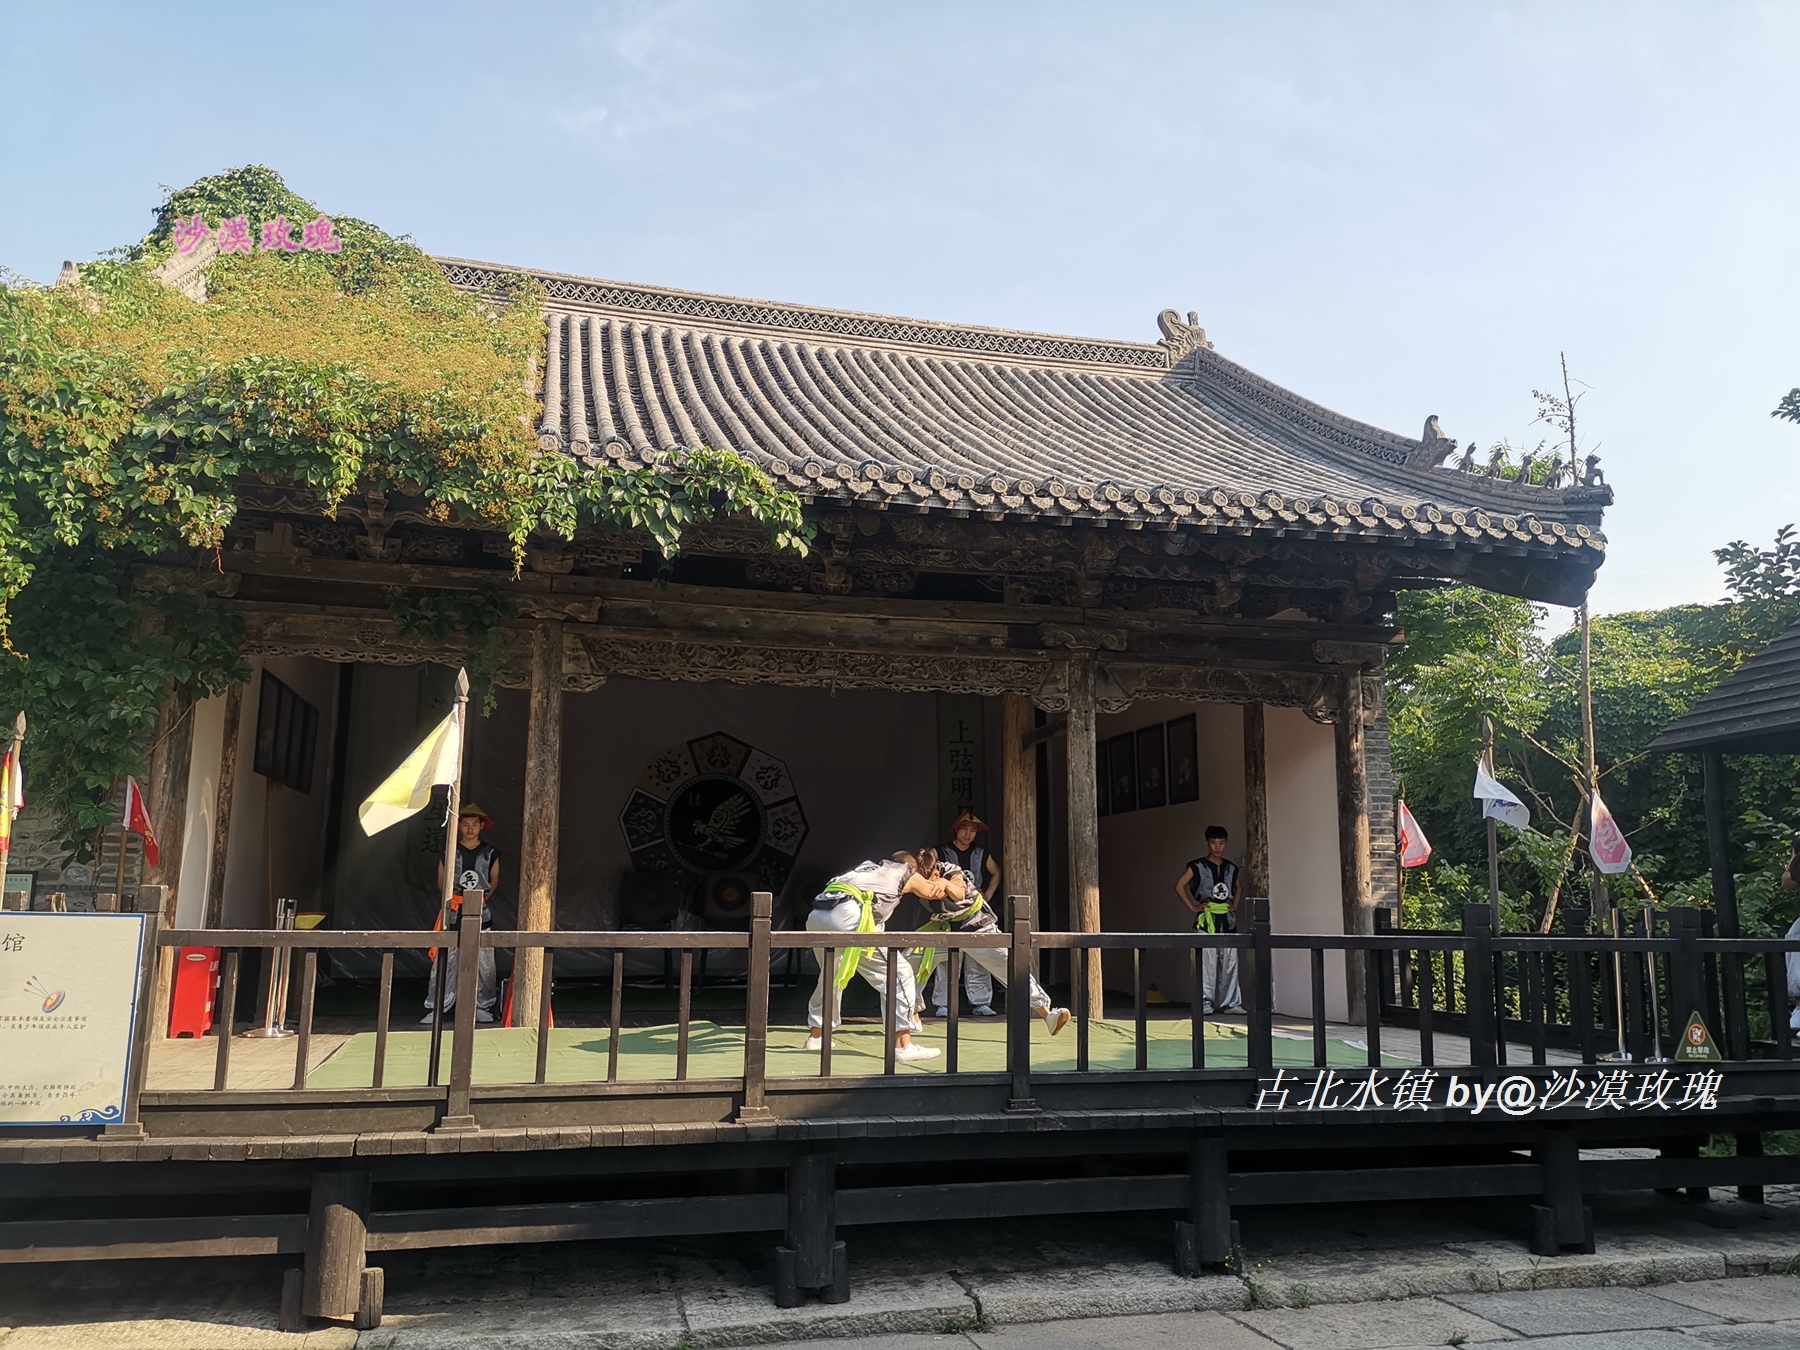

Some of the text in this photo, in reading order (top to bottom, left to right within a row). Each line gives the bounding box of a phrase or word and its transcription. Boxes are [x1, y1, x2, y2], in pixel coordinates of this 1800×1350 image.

[461, 872, 476, 886] 兵
[1214, 884, 1227, 897] 兵
[1, 933, 25, 952] 馆
